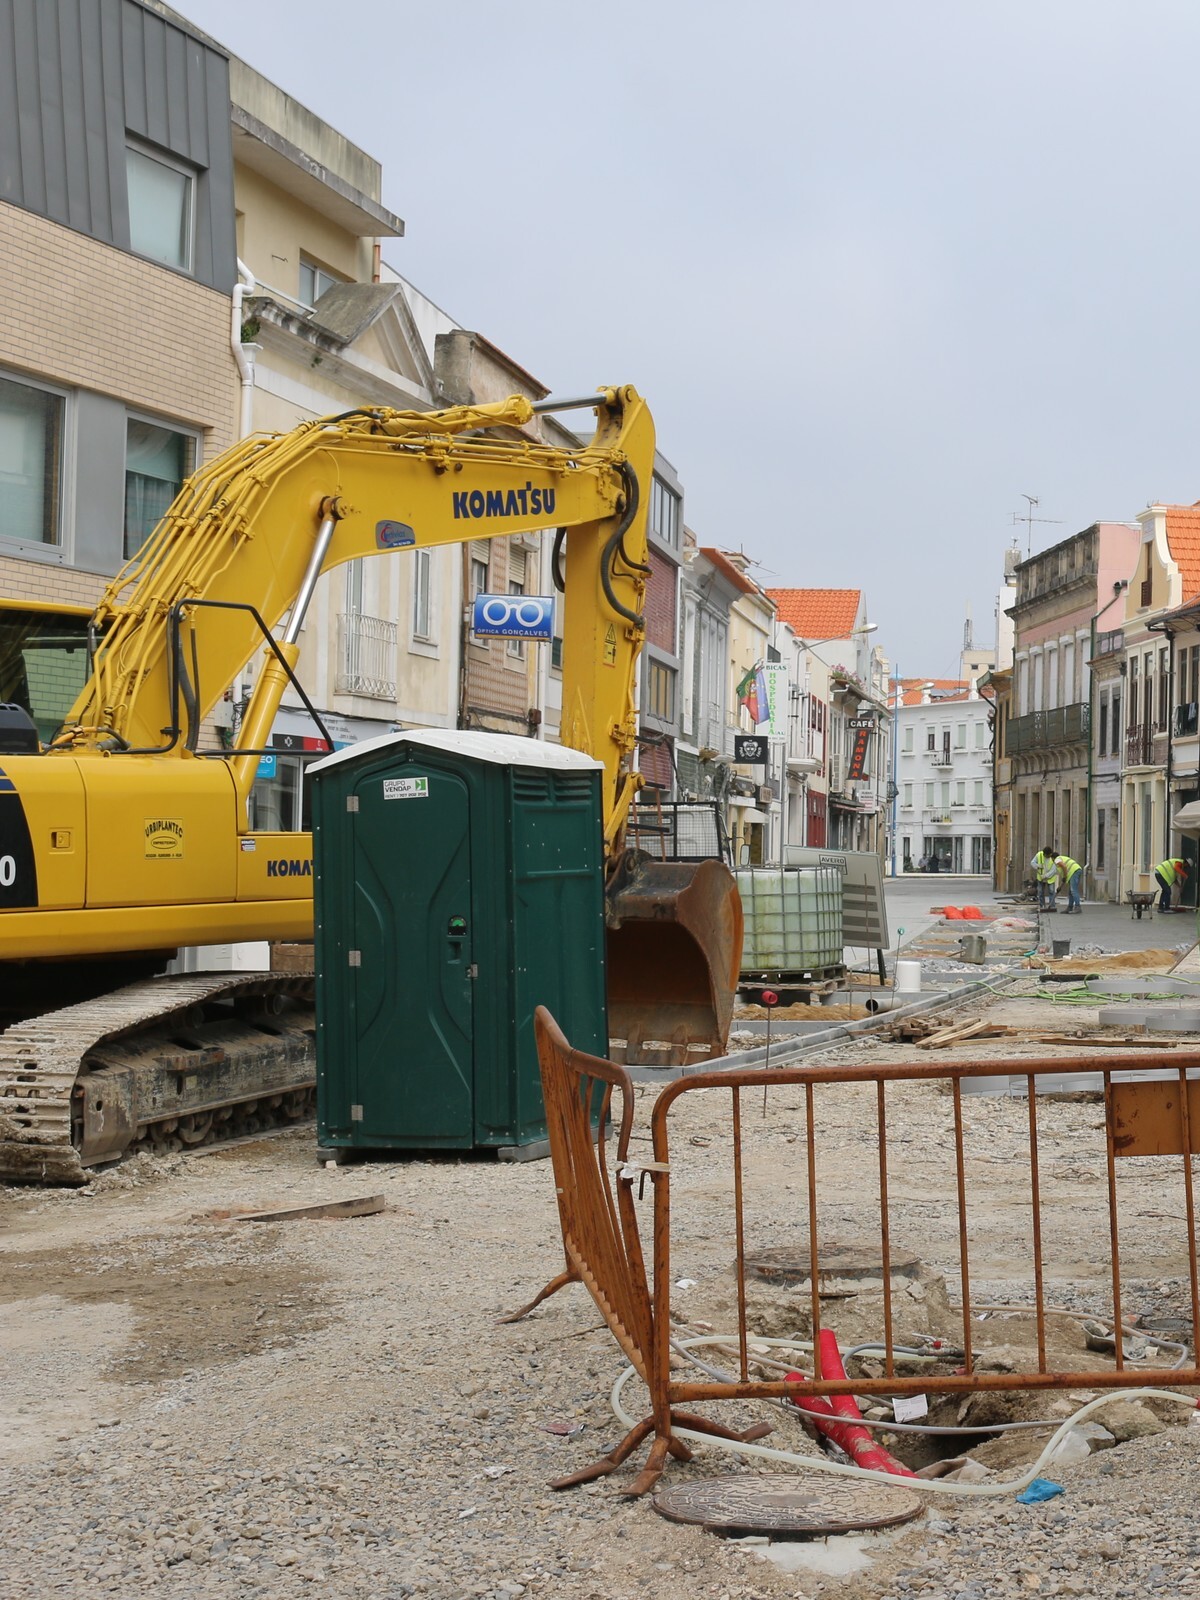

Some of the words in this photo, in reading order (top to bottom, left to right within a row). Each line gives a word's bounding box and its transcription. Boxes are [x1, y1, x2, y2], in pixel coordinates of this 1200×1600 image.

[452, 481, 556, 519] KOMATSU
[502, 628, 548, 637] GONÇALVES
[768, 672, 777, 735] HOSPEDARIA
[850, 719, 874, 728] CAFÉ
[852, 730, 867, 777] RAMONA
[384, 785, 412, 793] VENDAP
[144, 820, 184, 838] URBIPLANTEC
